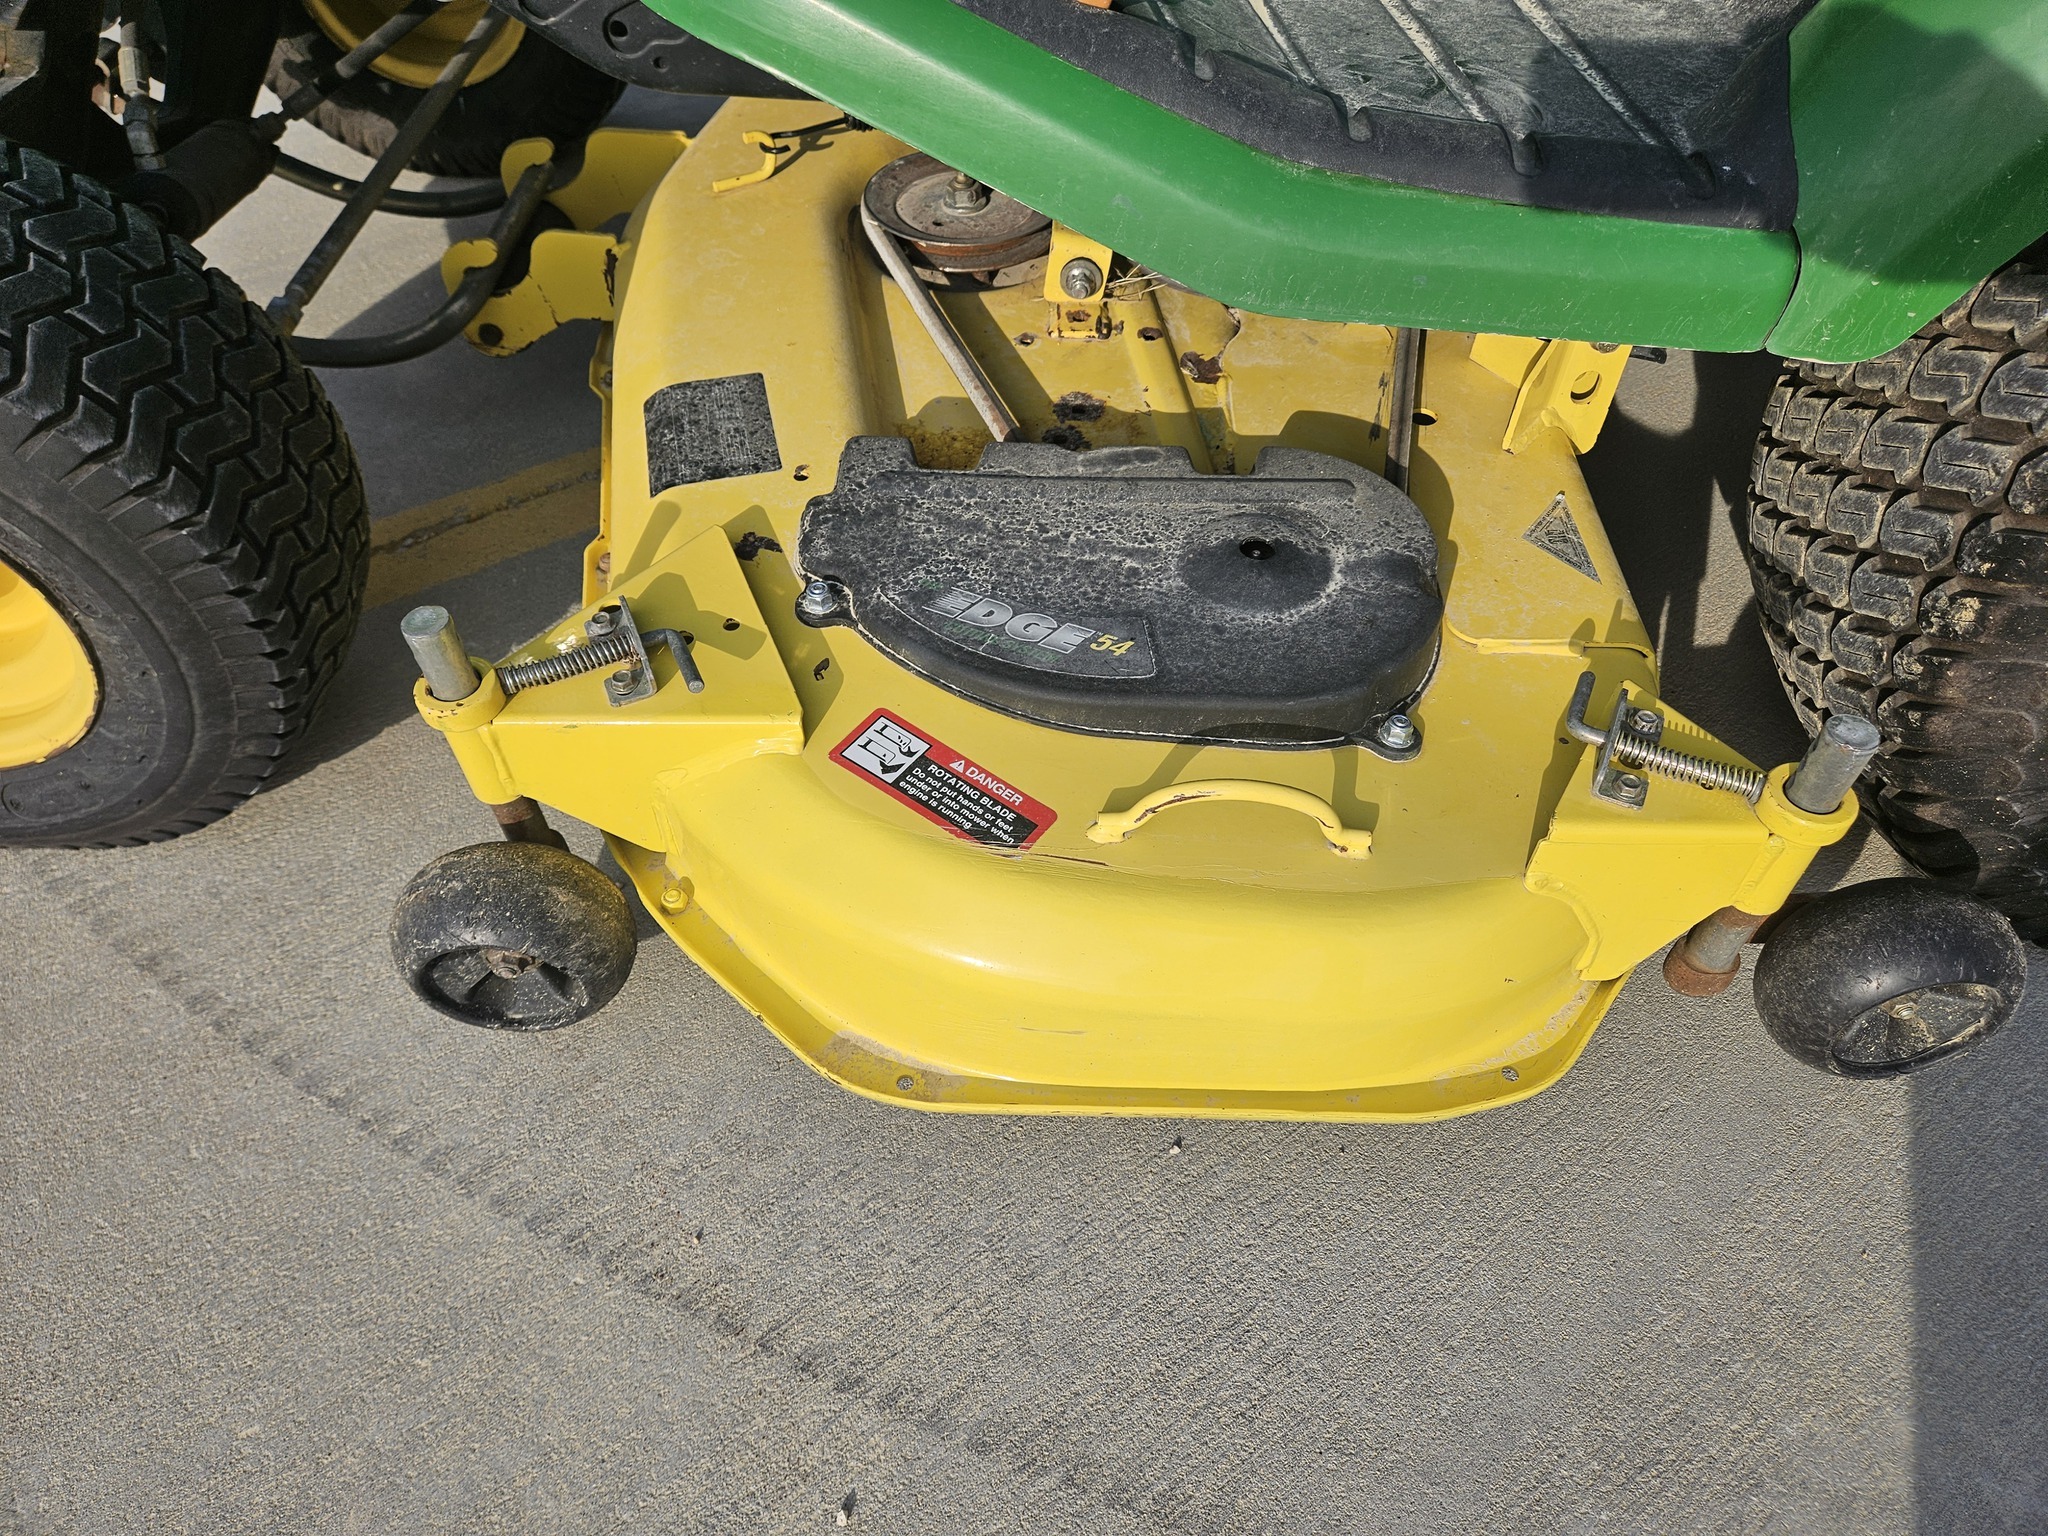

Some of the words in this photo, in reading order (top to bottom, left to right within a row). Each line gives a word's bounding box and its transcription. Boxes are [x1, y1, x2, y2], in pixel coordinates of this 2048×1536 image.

[921, 586, 1097, 654] EDGE
[1090, 634, 1136, 657] 54
[899, 781, 929, 802] engine
[928, 797, 937, 807] is
[937, 803, 973, 830] running
[905, 774, 932, 792] under
[931, 788, 943, 798] or
[942, 793, 960, 811] into
[959, 806, 991, 829] mower
[990, 826, 1015, 844] when
[912, 767, 926, 780] Do
[925, 775, 941, 789] not
[940, 783, 957, 799] put
[956, 793, 984, 815] hands
[984, 811, 996, 821] or
[995, 818, 1014, 834] feet
[927, 764, 981, 800] ROTATING
[979, 795, 1017, 822] BLADE
[965, 766, 1024, 806] DANGER
